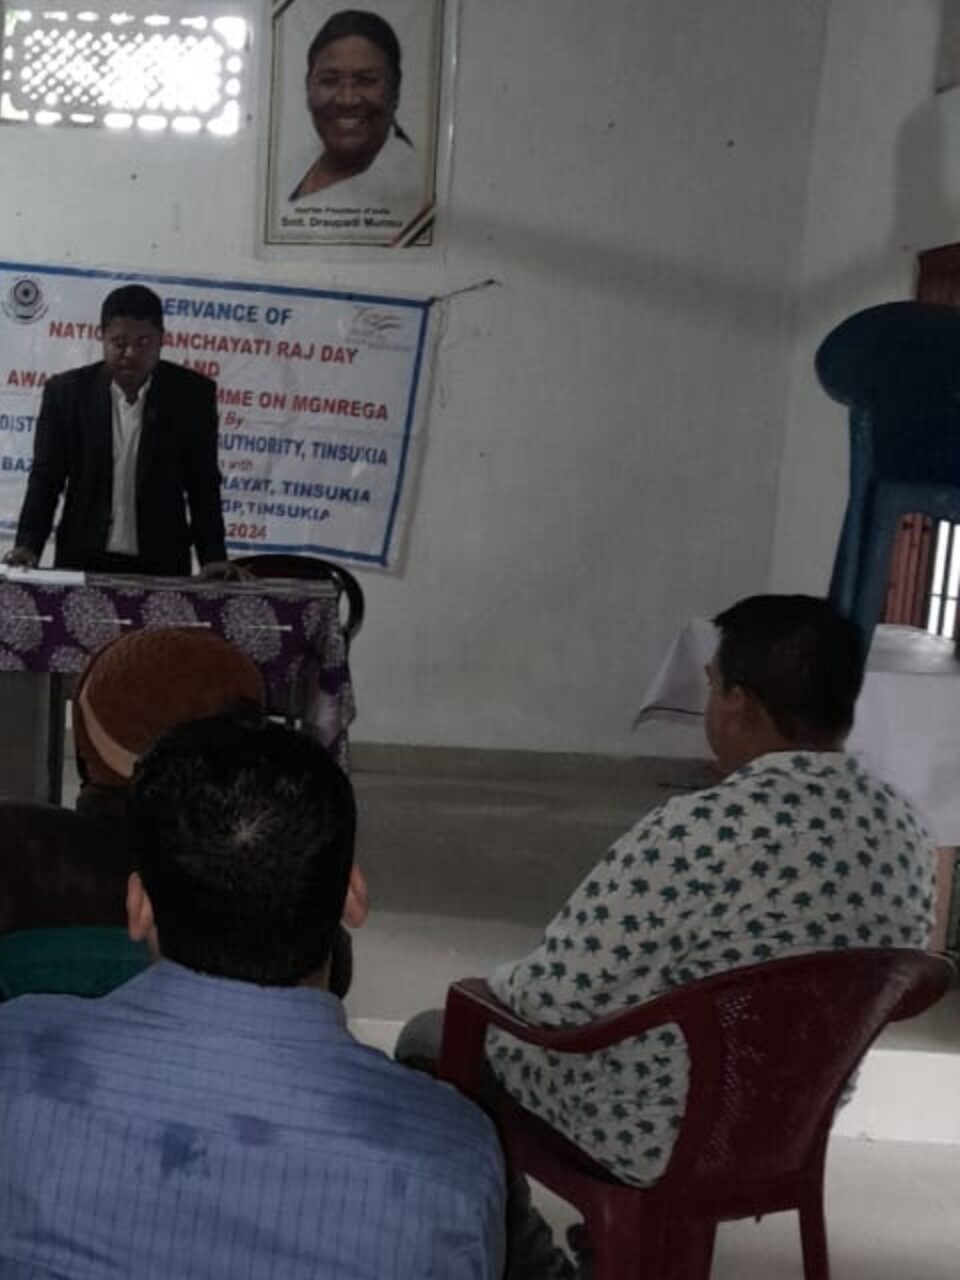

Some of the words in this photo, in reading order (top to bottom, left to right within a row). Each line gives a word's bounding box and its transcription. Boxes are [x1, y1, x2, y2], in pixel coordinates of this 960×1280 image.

[162, 297, 258, 324] ERVANCE
[265, 308, 293, 326] OF
[160, 331, 271, 357] ANCHAYATI
[277, 341, 315, 361] RAJ
[320, 345, 359, 365] DAY
[259, 393, 286, 409] ON
[292, 394, 388, 421] MGNREGA
[312, 441, 387, 466] TINSUKIA
[282, 481, 370, 503] TINSUKIA
